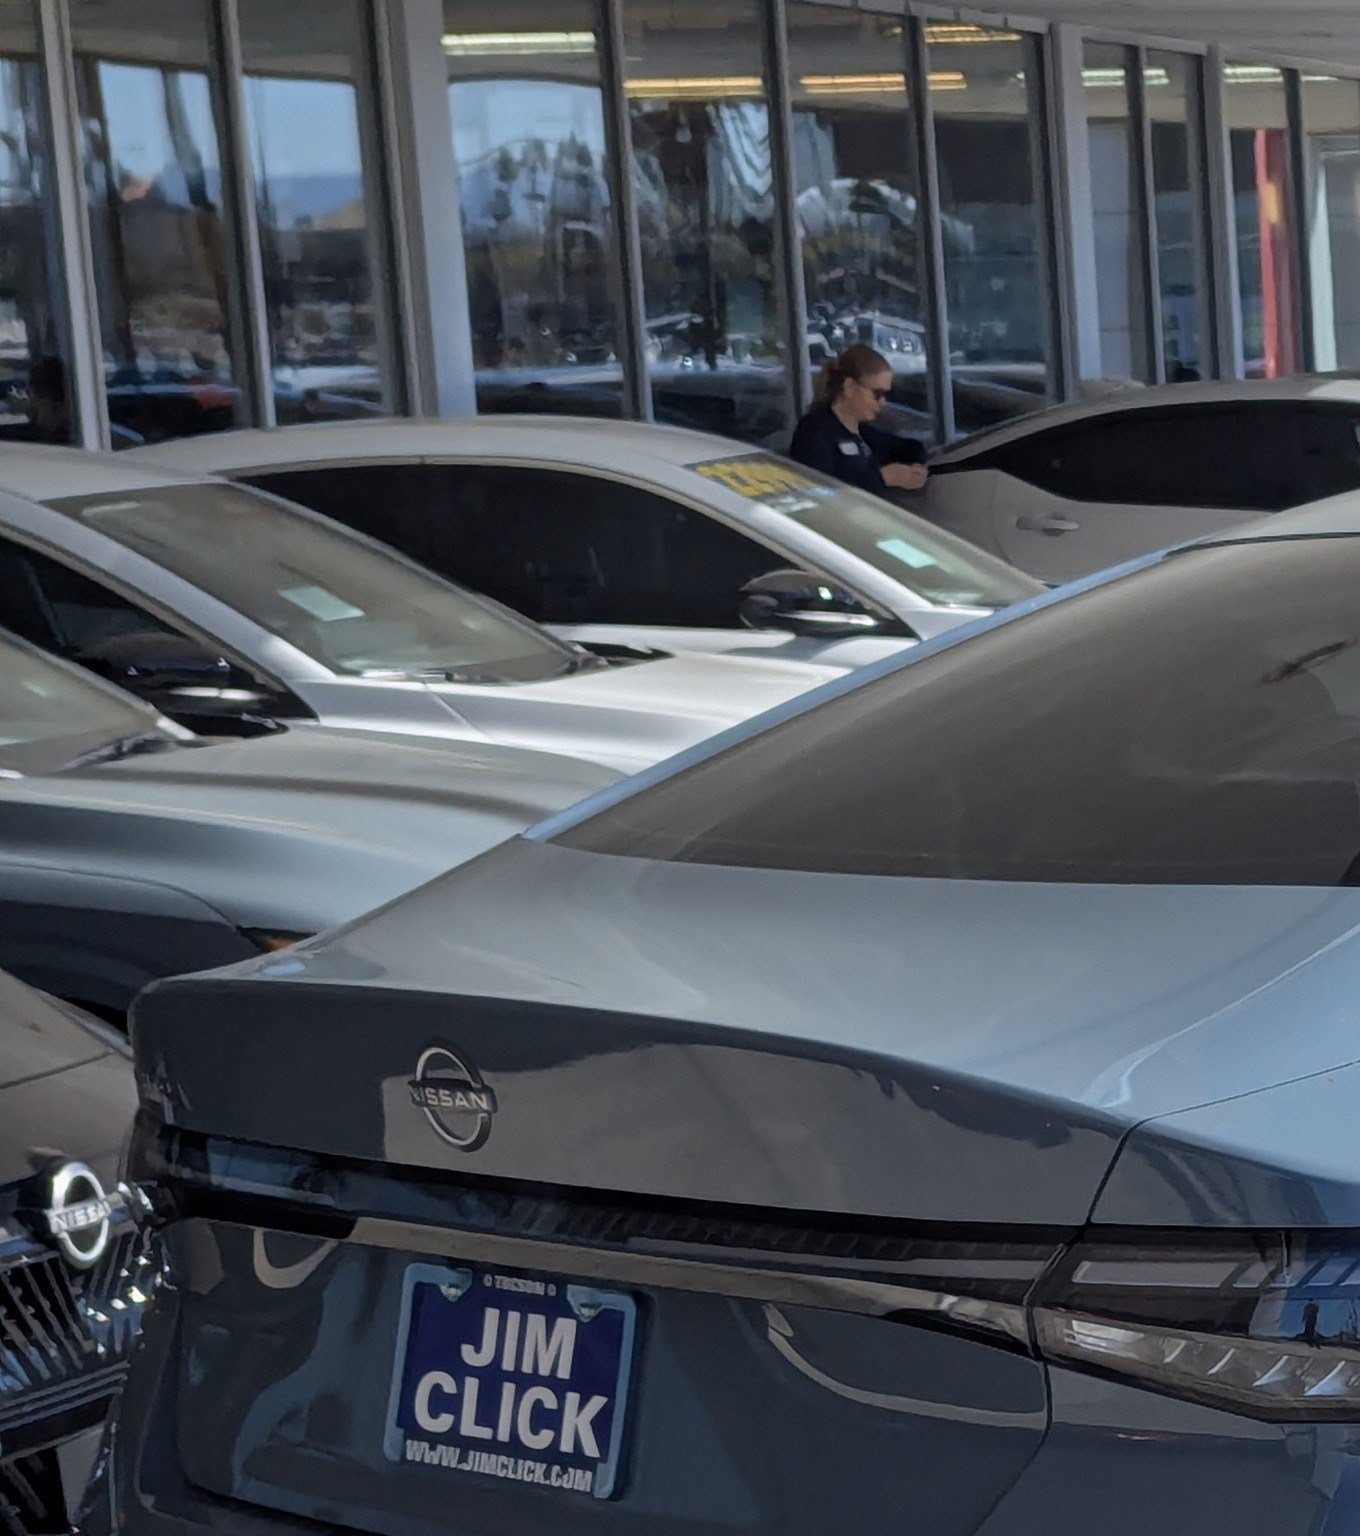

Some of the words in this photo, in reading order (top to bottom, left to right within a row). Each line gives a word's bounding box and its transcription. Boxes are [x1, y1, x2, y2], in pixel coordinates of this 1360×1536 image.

[410, 1085, 490, 1110] NISSAN
[460, 1307, 578, 1380] JIM
[414, 1370, 608, 1459] CLICK
[406, 1439, 593, 1492] WWW.JIMCLICK.COM
